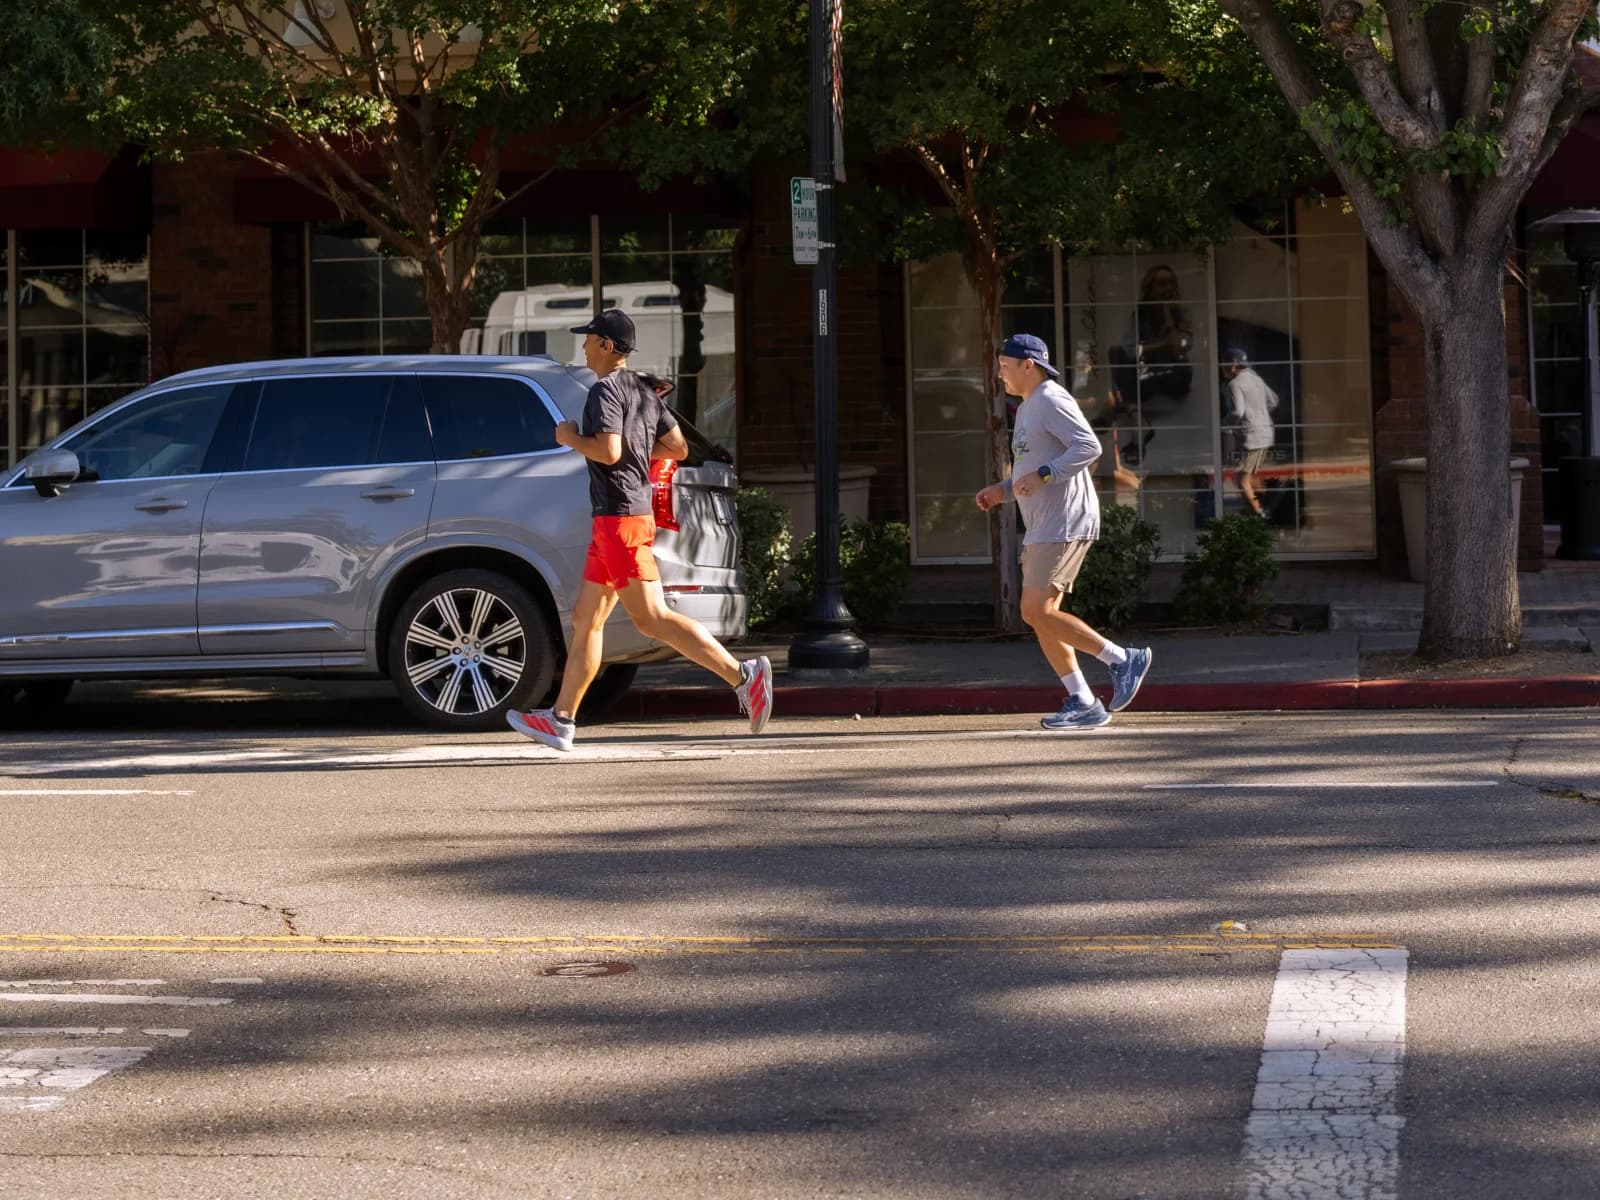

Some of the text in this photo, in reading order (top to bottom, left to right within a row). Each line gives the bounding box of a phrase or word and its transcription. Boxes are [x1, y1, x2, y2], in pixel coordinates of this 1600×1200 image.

[793, 182, 815, 201] 2 HOUR
[794, 207, 817, 222] PARKING
